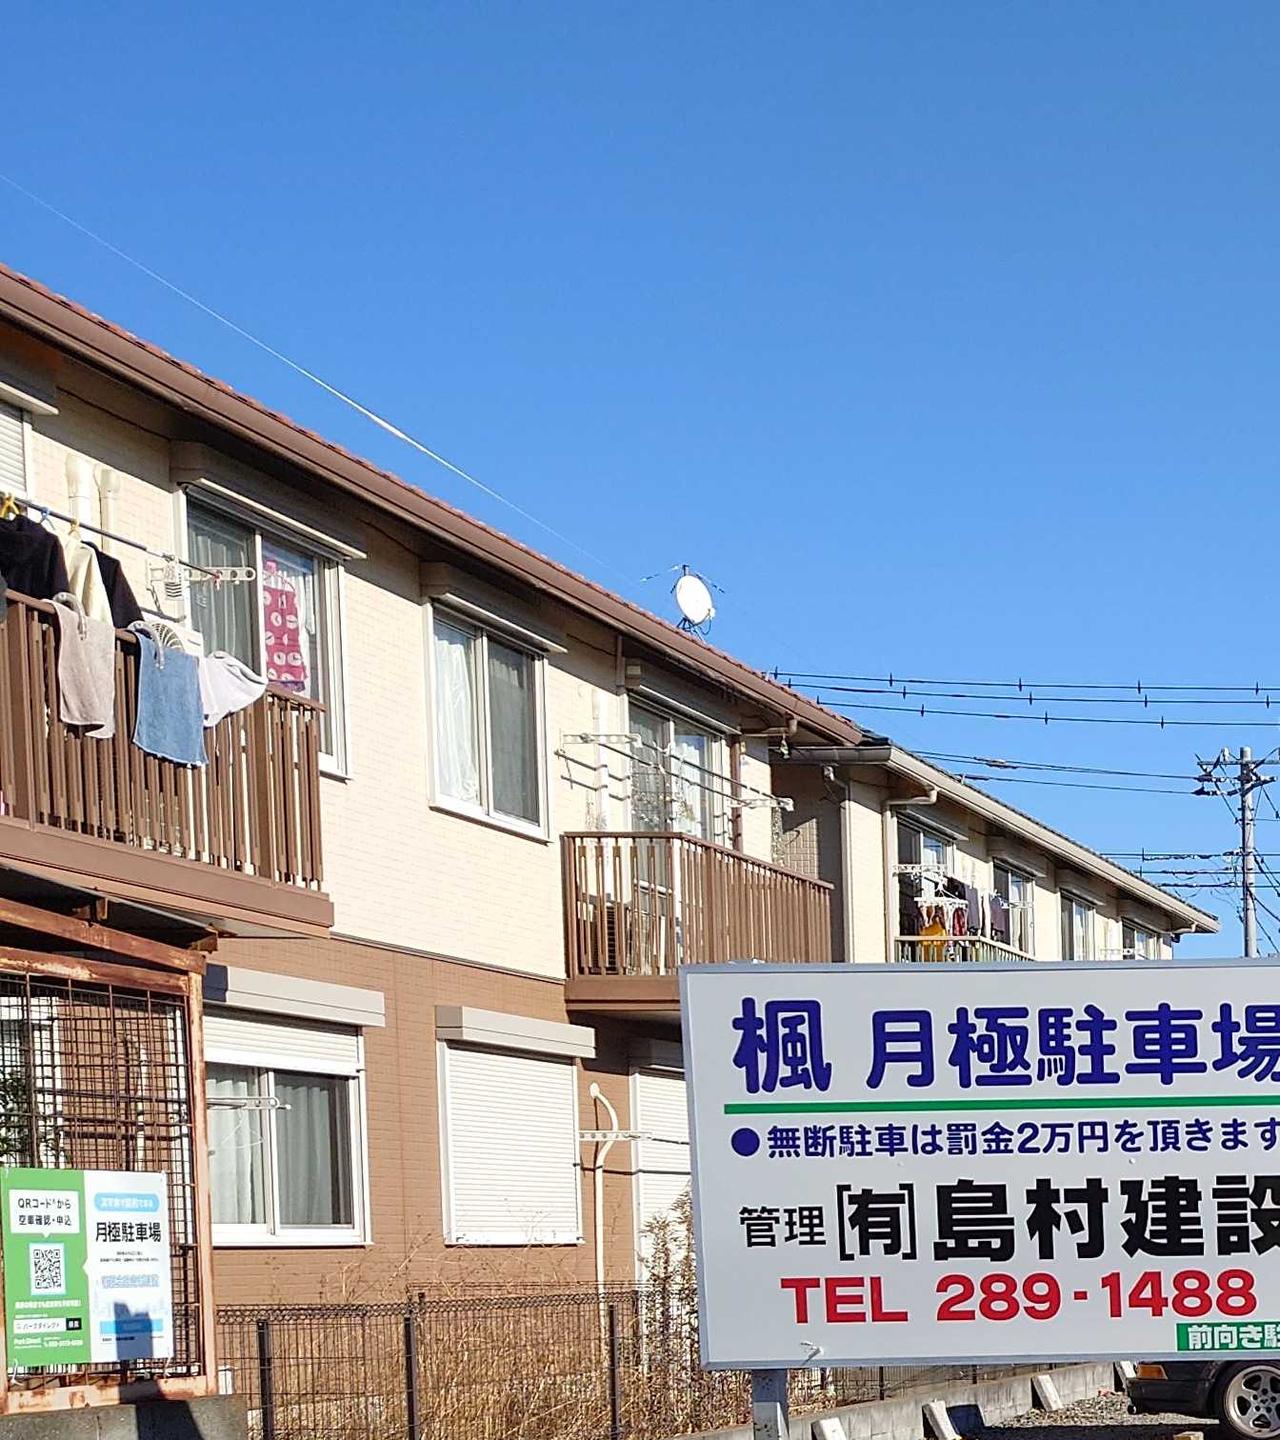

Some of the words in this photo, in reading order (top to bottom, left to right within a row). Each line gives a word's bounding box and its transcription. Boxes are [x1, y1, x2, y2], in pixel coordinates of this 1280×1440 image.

[731, 997, 832, 1094] 楓
[96, 1222, 161, 1242] 月極駐車場
[739, 1205, 827, 1249] 管理
[780, 1276, 909, 1325] TEL
[936, 1269, 1258, 1323] 289-1488
